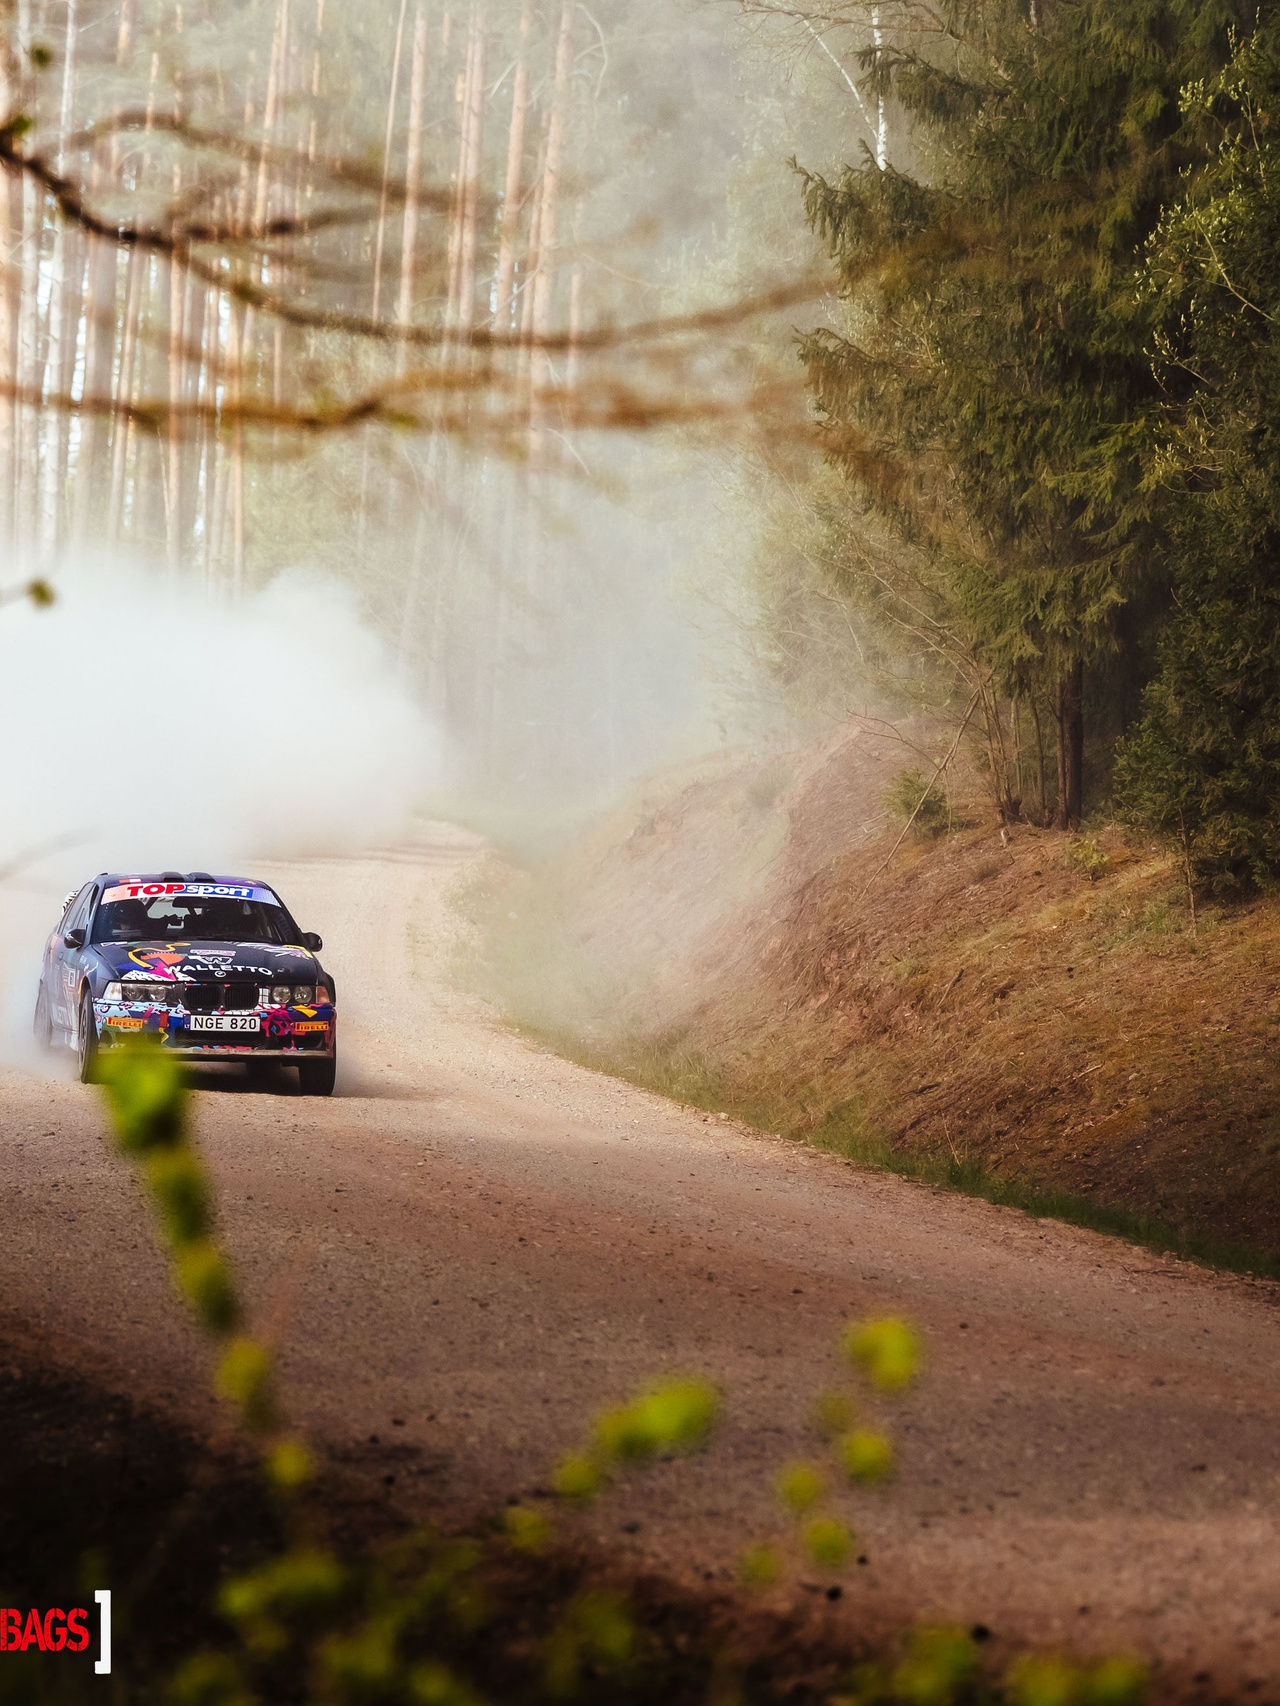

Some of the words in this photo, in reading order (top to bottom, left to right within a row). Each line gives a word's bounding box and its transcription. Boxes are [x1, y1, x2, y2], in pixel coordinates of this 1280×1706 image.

[164, 964, 273, 976] WALLETTO
[194, 1017, 224, 1029] NGE
[230, 1017, 257, 1030] 820
[296, 1022, 328, 1030] PIRELLI
